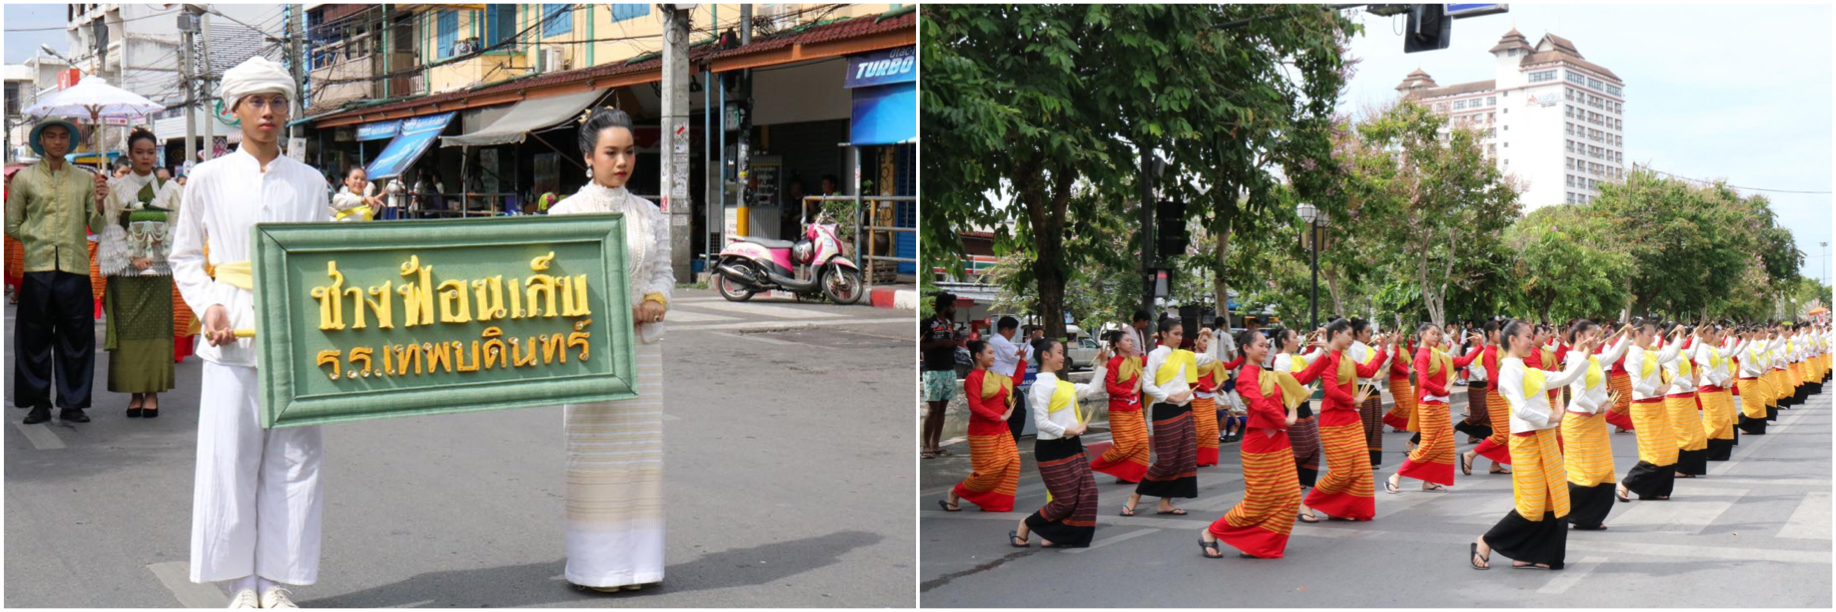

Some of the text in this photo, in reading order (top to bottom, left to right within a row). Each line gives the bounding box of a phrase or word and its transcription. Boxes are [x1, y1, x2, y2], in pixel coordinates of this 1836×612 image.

[855, 55, 915, 80] TURBO
[311, 251, 591, 330] ช่างฟ้อนเล็บ
[317, 319, 592, 379] ร.ร.เทพบดินทร์
